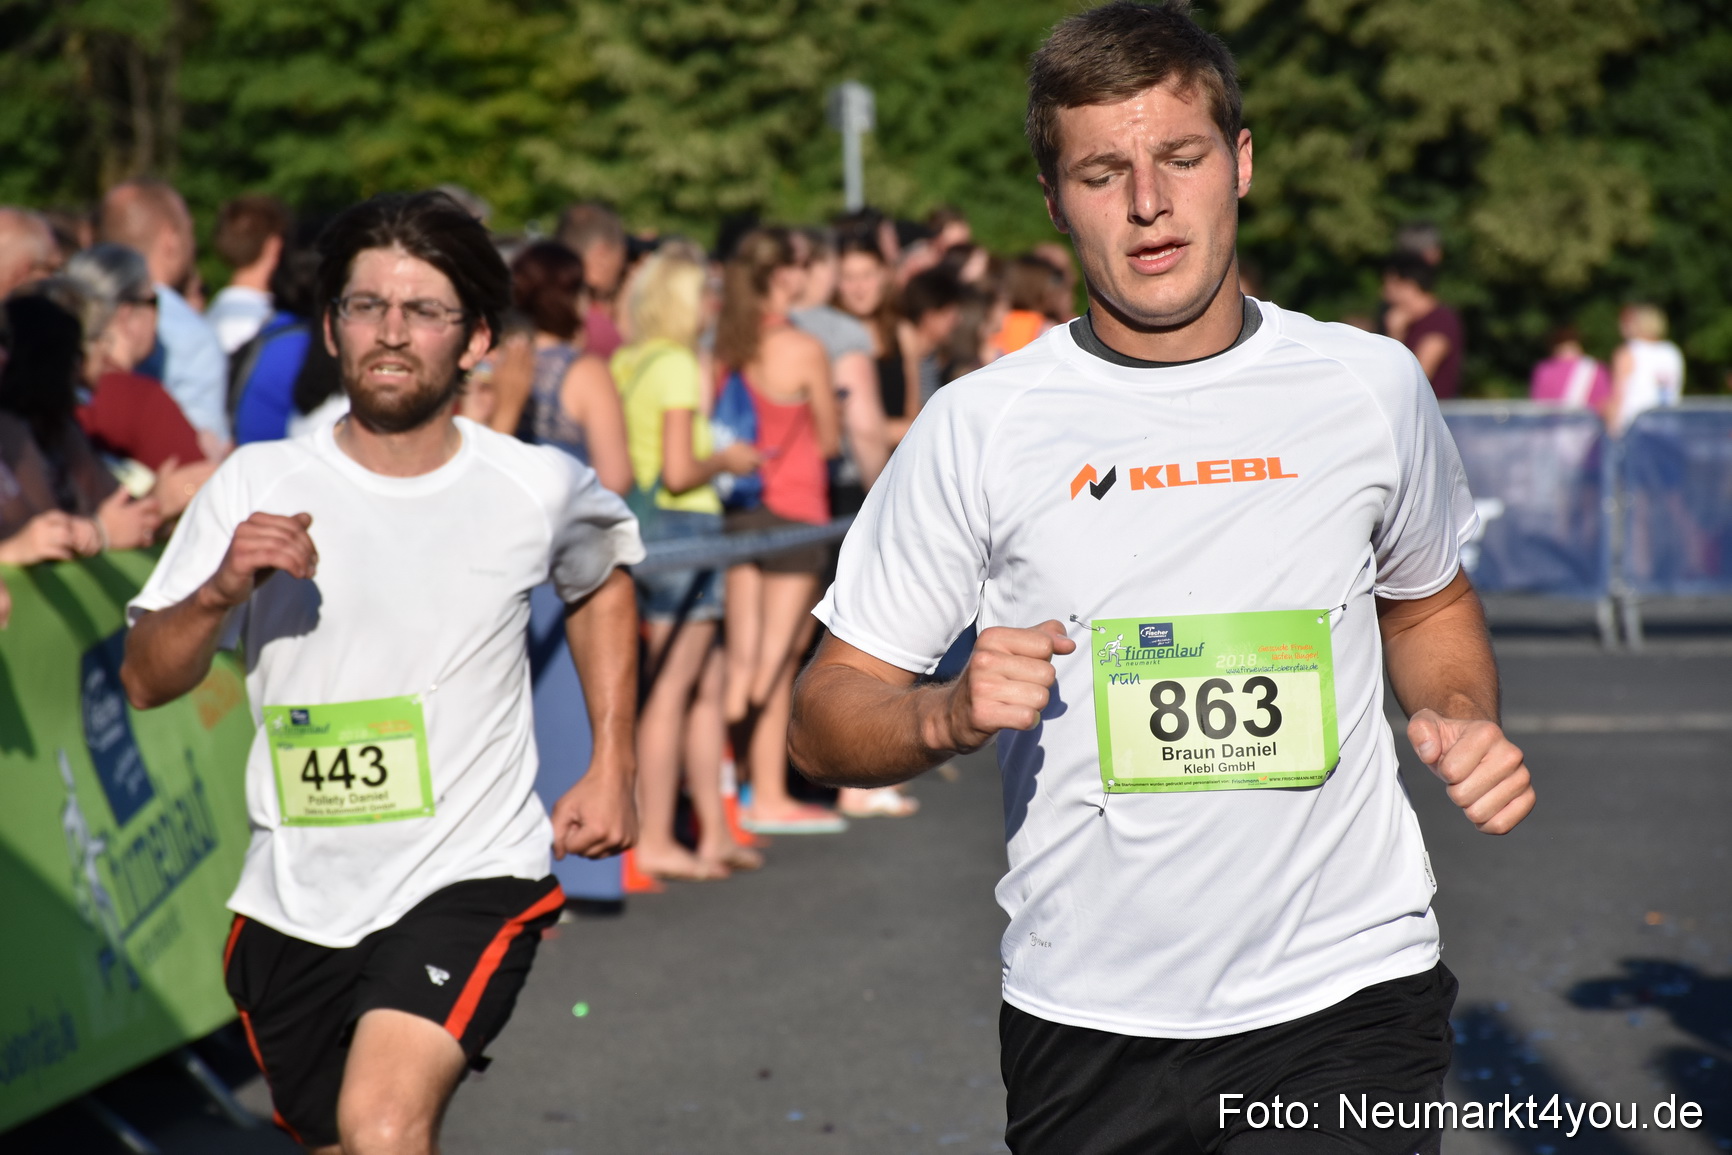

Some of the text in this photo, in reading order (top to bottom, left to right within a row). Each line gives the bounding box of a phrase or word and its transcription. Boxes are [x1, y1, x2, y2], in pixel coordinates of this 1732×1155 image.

[1129, 457, 1298, 490] KLEBL
[1125, 641, 1206, 660] firmenlauf
[1215, 653, 1257, 669] 2018
[1149, 676, 1282, 742] 863
[1161, 742, 1277, 762] Braun Daniel
[301, 745, 388, 791] 443
[1184, 761, 1256, 774] Klebl GmbH
[349, 790, 389, 804] Daniel
